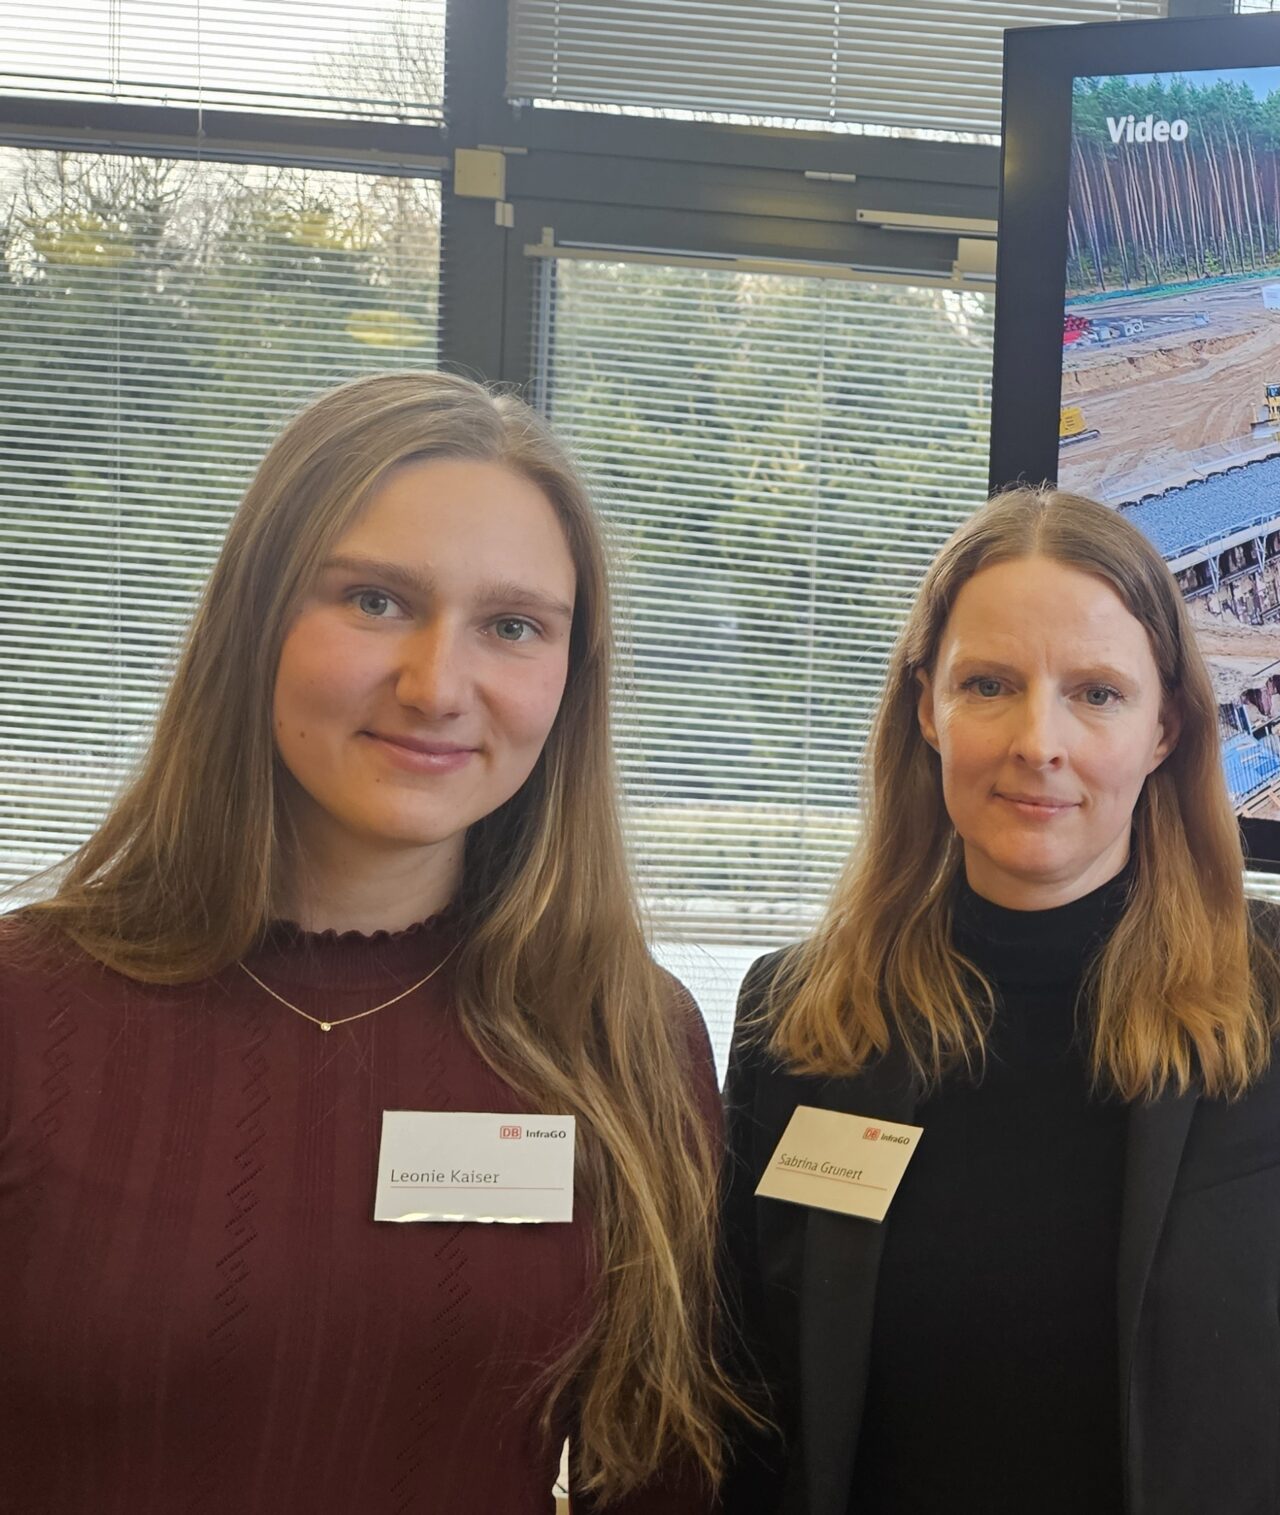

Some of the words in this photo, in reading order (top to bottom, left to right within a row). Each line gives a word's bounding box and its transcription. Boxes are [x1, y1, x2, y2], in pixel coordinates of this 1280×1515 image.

[1106, 113, 1189, 144] Video
[526, 1129, 567, 1139] InfraGO
[881, 1133, 910, 1146] InfraGO
[778, 1153, 818, 1172] Sabrina
[820, 1161, 863, 1181] Grunert
[391, 1168, 445, 1183] Leonie
[451, 1169, 500, 1184] Kaiser
